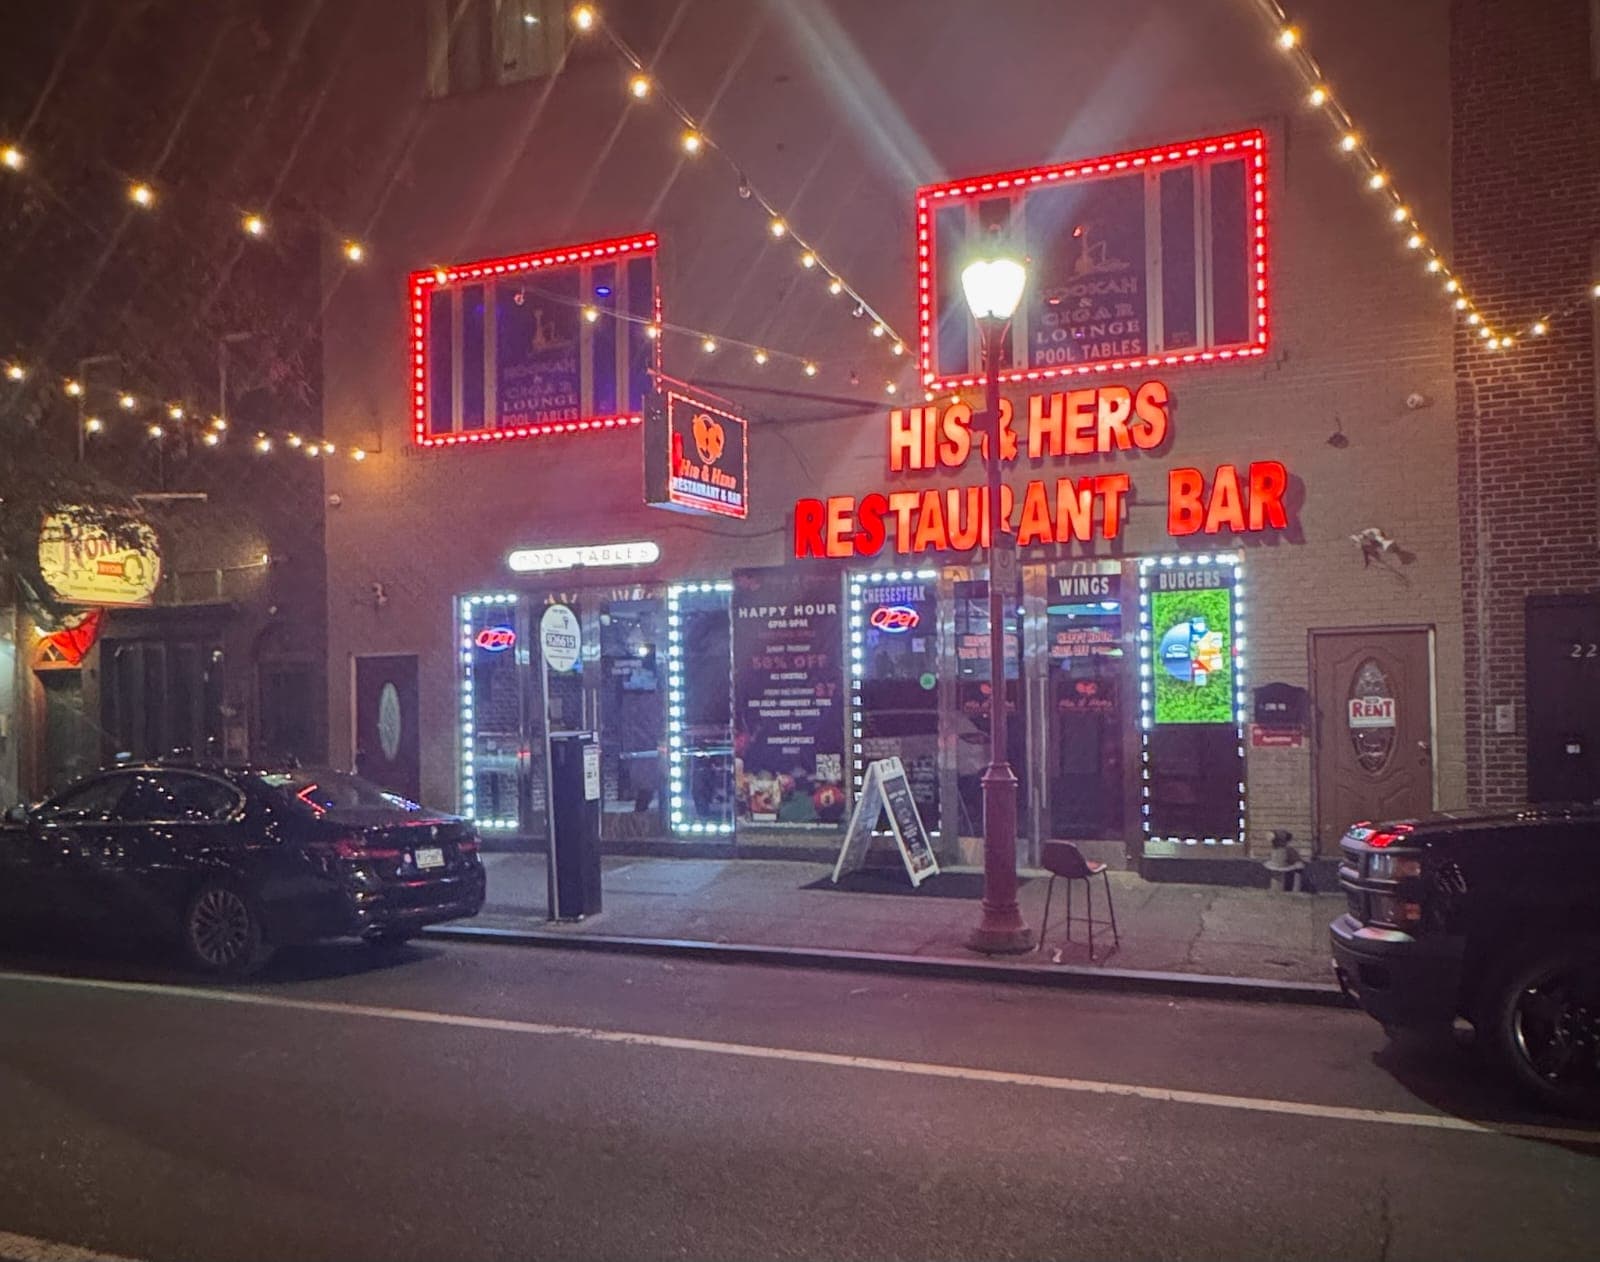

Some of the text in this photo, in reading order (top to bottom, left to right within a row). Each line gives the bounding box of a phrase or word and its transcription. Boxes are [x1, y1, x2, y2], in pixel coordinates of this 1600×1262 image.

[1036, 320, 1140, 344] LOUNGE
[1035, 338, 1142, 365] POOL TABLES
[503, 394, 578, 412] LOUNGE
[890, 403, 973, 471] HIS
[1028, 381, 1168, 458] HERS
[795, 461, 1288, 559] RESTAURANT BAR
[576, 546, 648, 563] TABLES
[1059, 577, 1110, 596] WINGS
[1159, 571, 1221, 589] BURGERS
[863, 586, 925, 604] CHEESESTEAK
[738, 603, 838, 619] HAPPY HOUR
[794, 652, 828, 669] OFF
[1351, 701, 1394, 718] RENT
